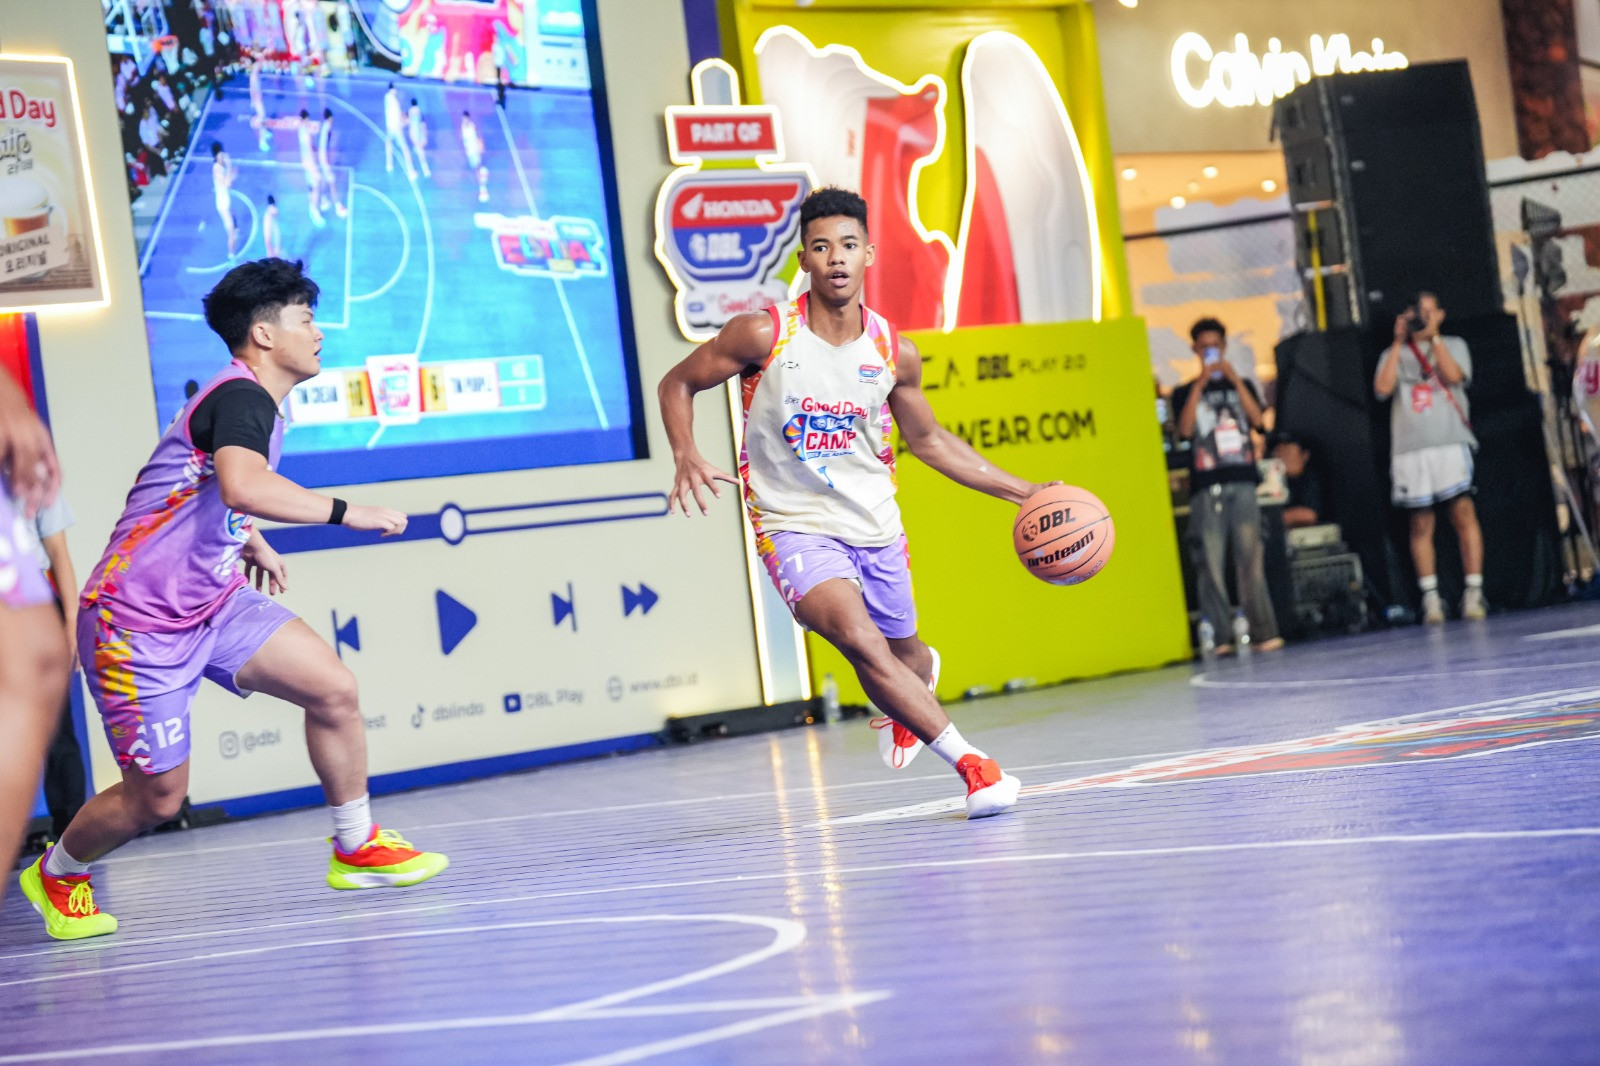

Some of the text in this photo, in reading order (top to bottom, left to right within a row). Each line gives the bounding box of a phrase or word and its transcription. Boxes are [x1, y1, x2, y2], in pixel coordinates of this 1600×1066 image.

[1171, 31, 1311, 108] Calvin
[10, 90, 56, 128] Day
[690, 121, 762, 143] PART OF
[703, 199, 776, 219] HONDA
[706, 232, 746, 260] DBL
[977, 354, 1014, 381] DBL
[801, 396, 840, 415] Good
[841, 401, 869, 420] Day
[806, 430, 857, 450] CAMP
[896, 406, 1096, 456] WEAR.COM
[1039, 507, 1076, 534] DBL
[1027, 530, 1095, 568] proteam
[556, 688, 583, 704] Play
[151, 717, 185, 749] 12
[243, 728, 281, 753] @dbl
